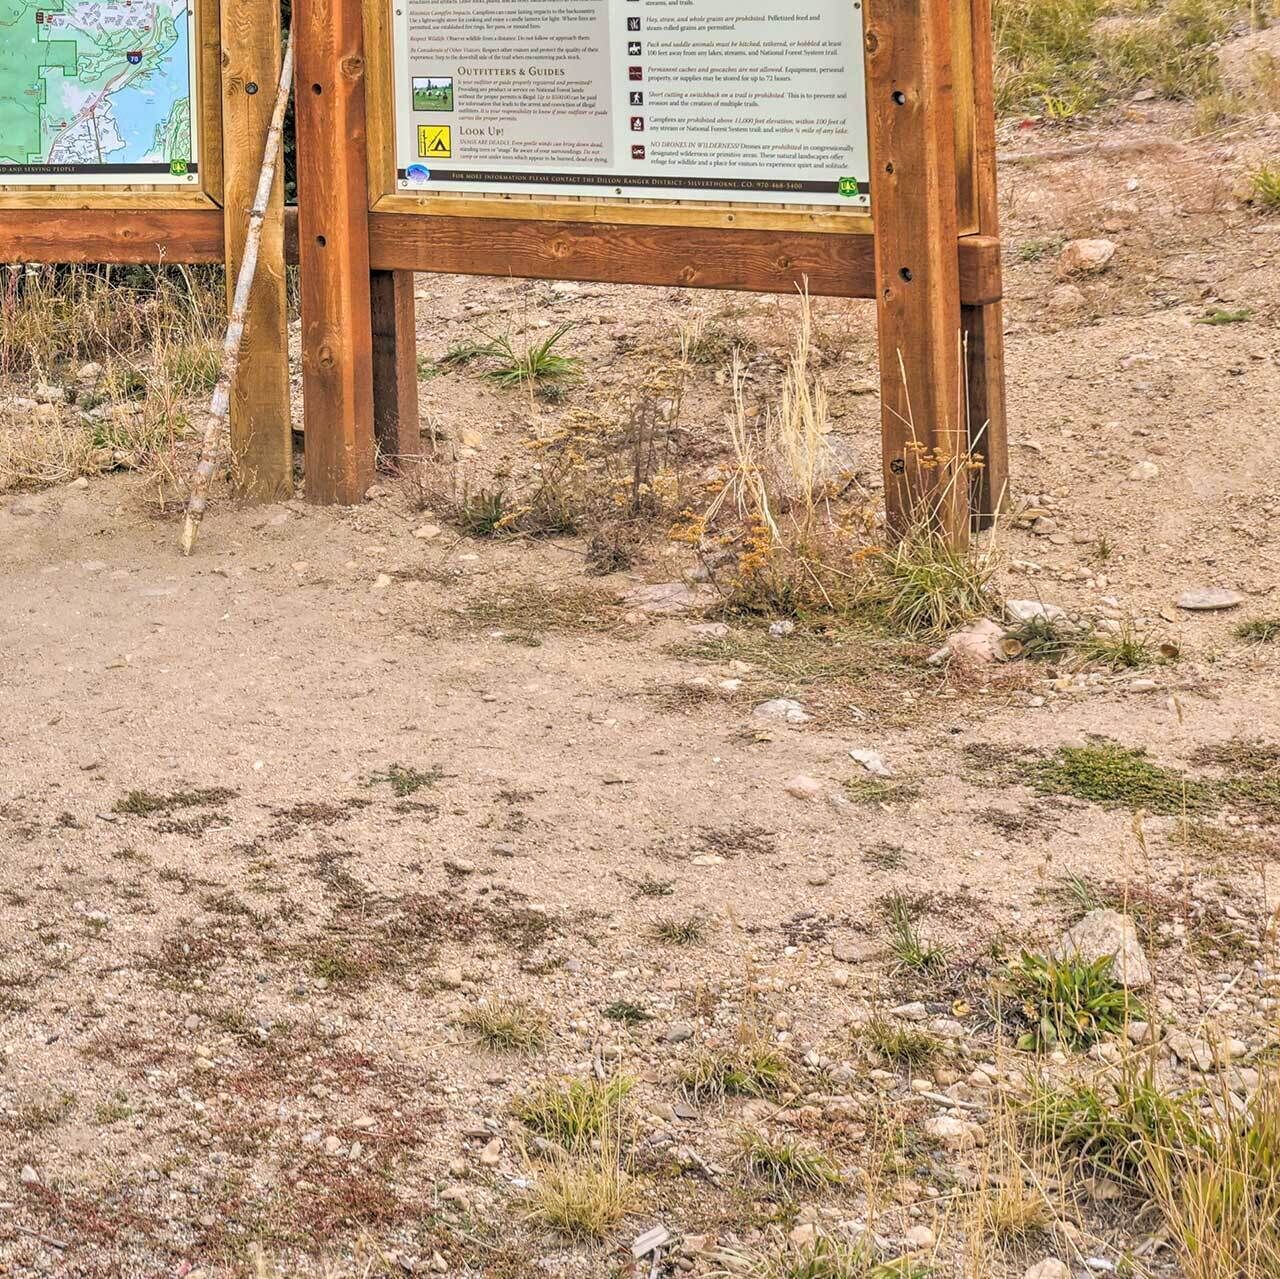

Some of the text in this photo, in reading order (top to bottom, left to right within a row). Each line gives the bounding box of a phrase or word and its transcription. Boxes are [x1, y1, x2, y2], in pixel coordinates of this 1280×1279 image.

[457, 66, 565, 76] OUTFITTERS & GUIDES
[459, 126, 504, 136] LOOK UP!
